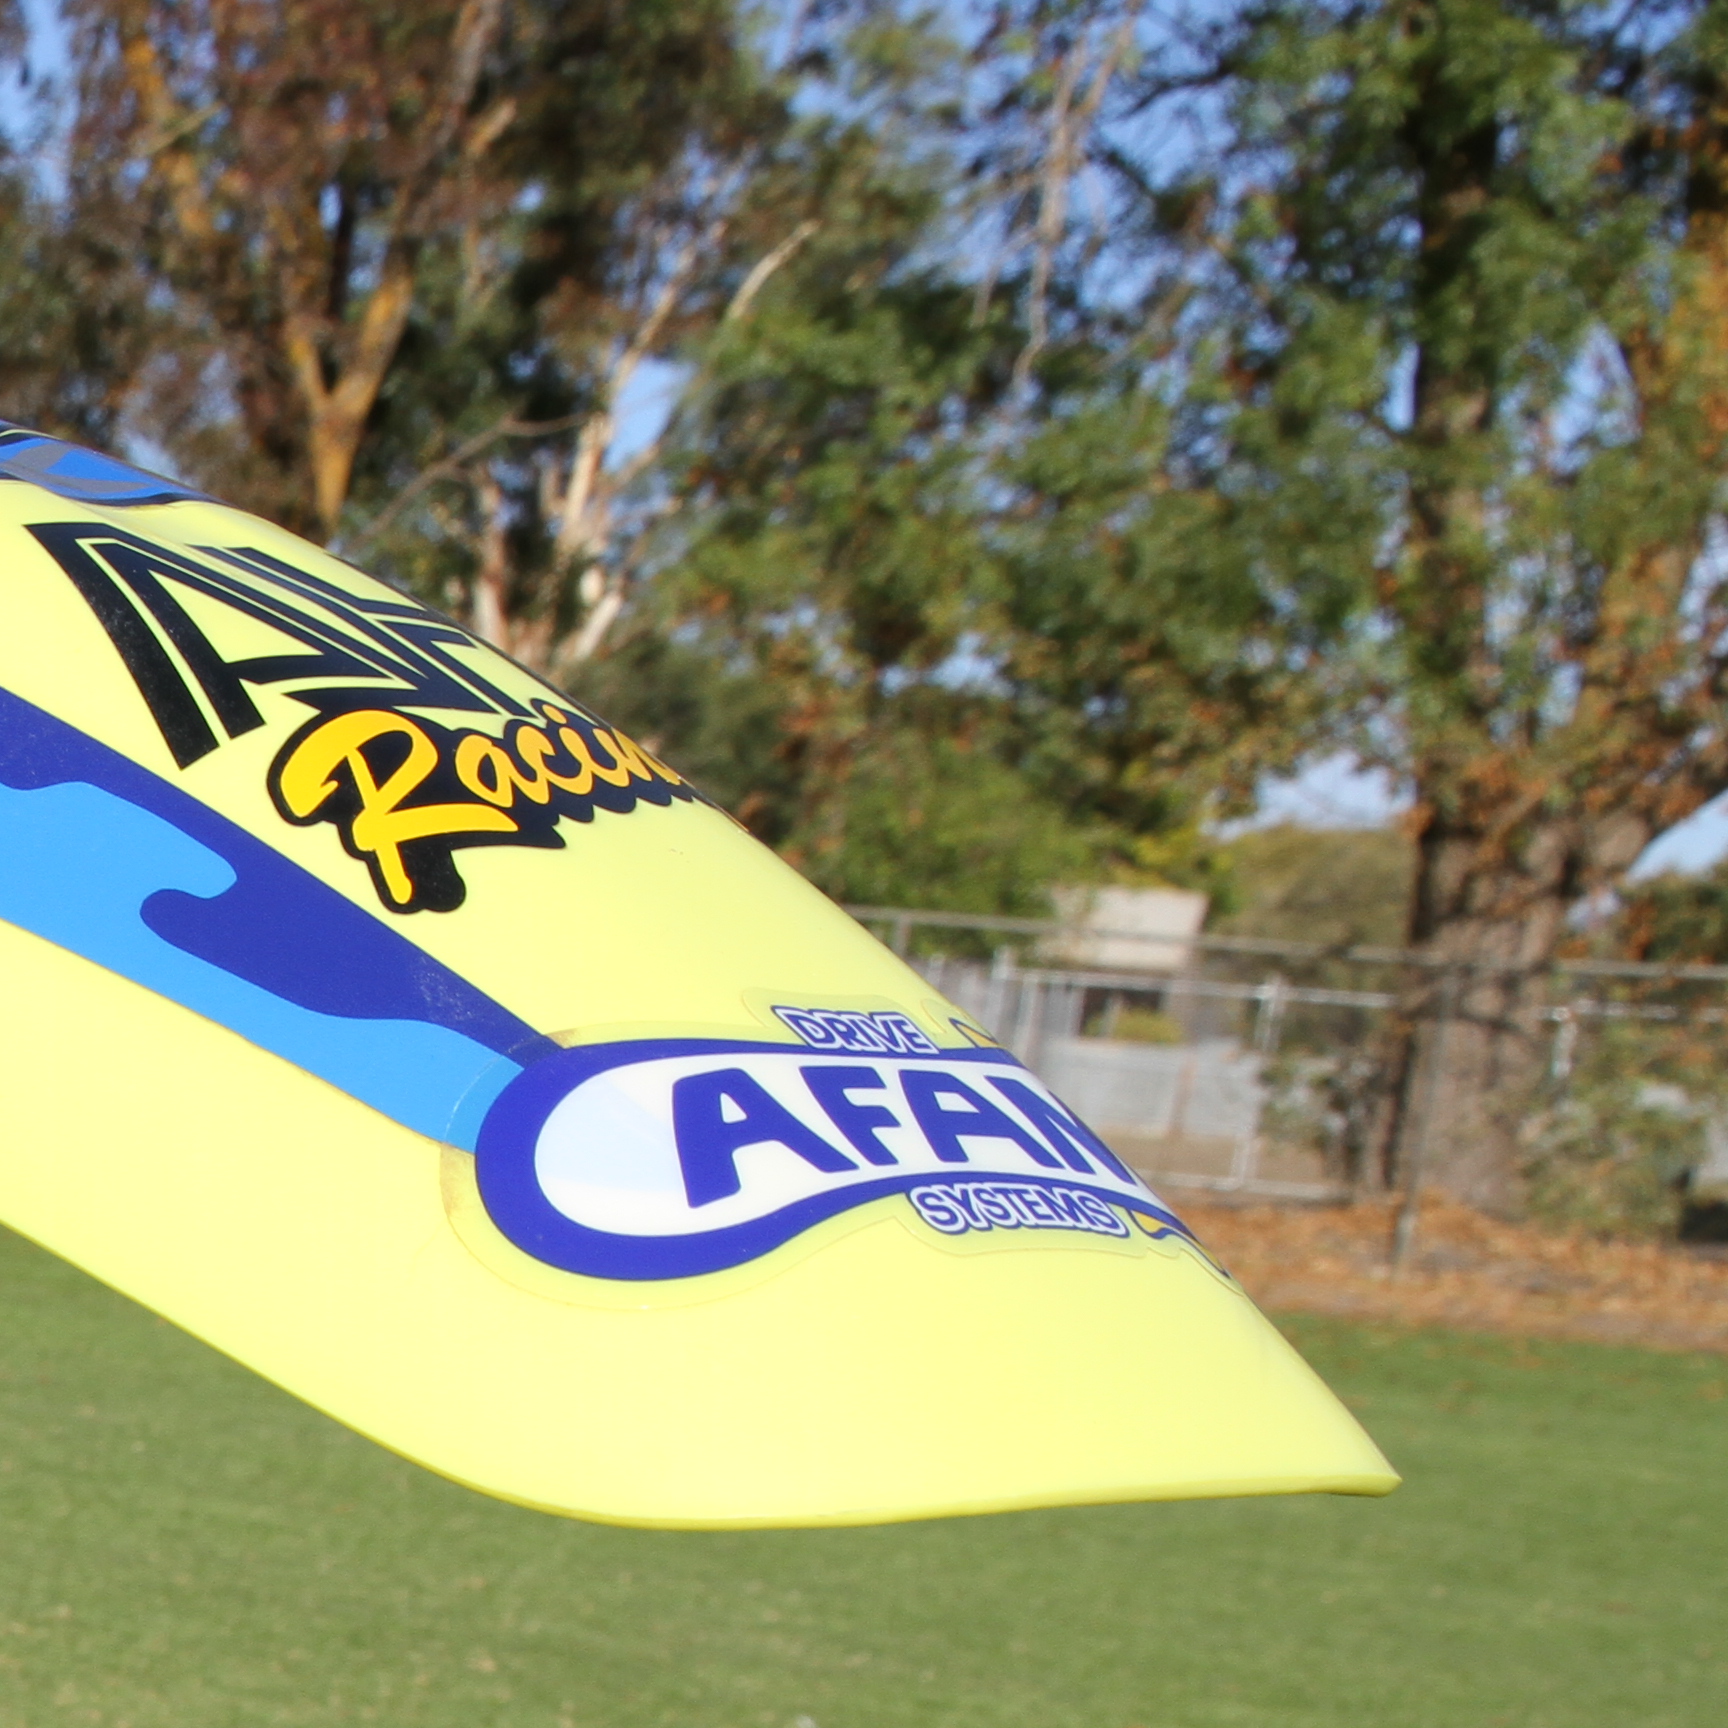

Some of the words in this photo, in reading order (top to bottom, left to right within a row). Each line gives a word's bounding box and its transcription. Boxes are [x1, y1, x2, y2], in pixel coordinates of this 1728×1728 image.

[268, 699, 699, 912] Racin
[772, 1005, 940, 1056] DRIVE
[908, 1183, 1131, 1239] SYSTEMS
